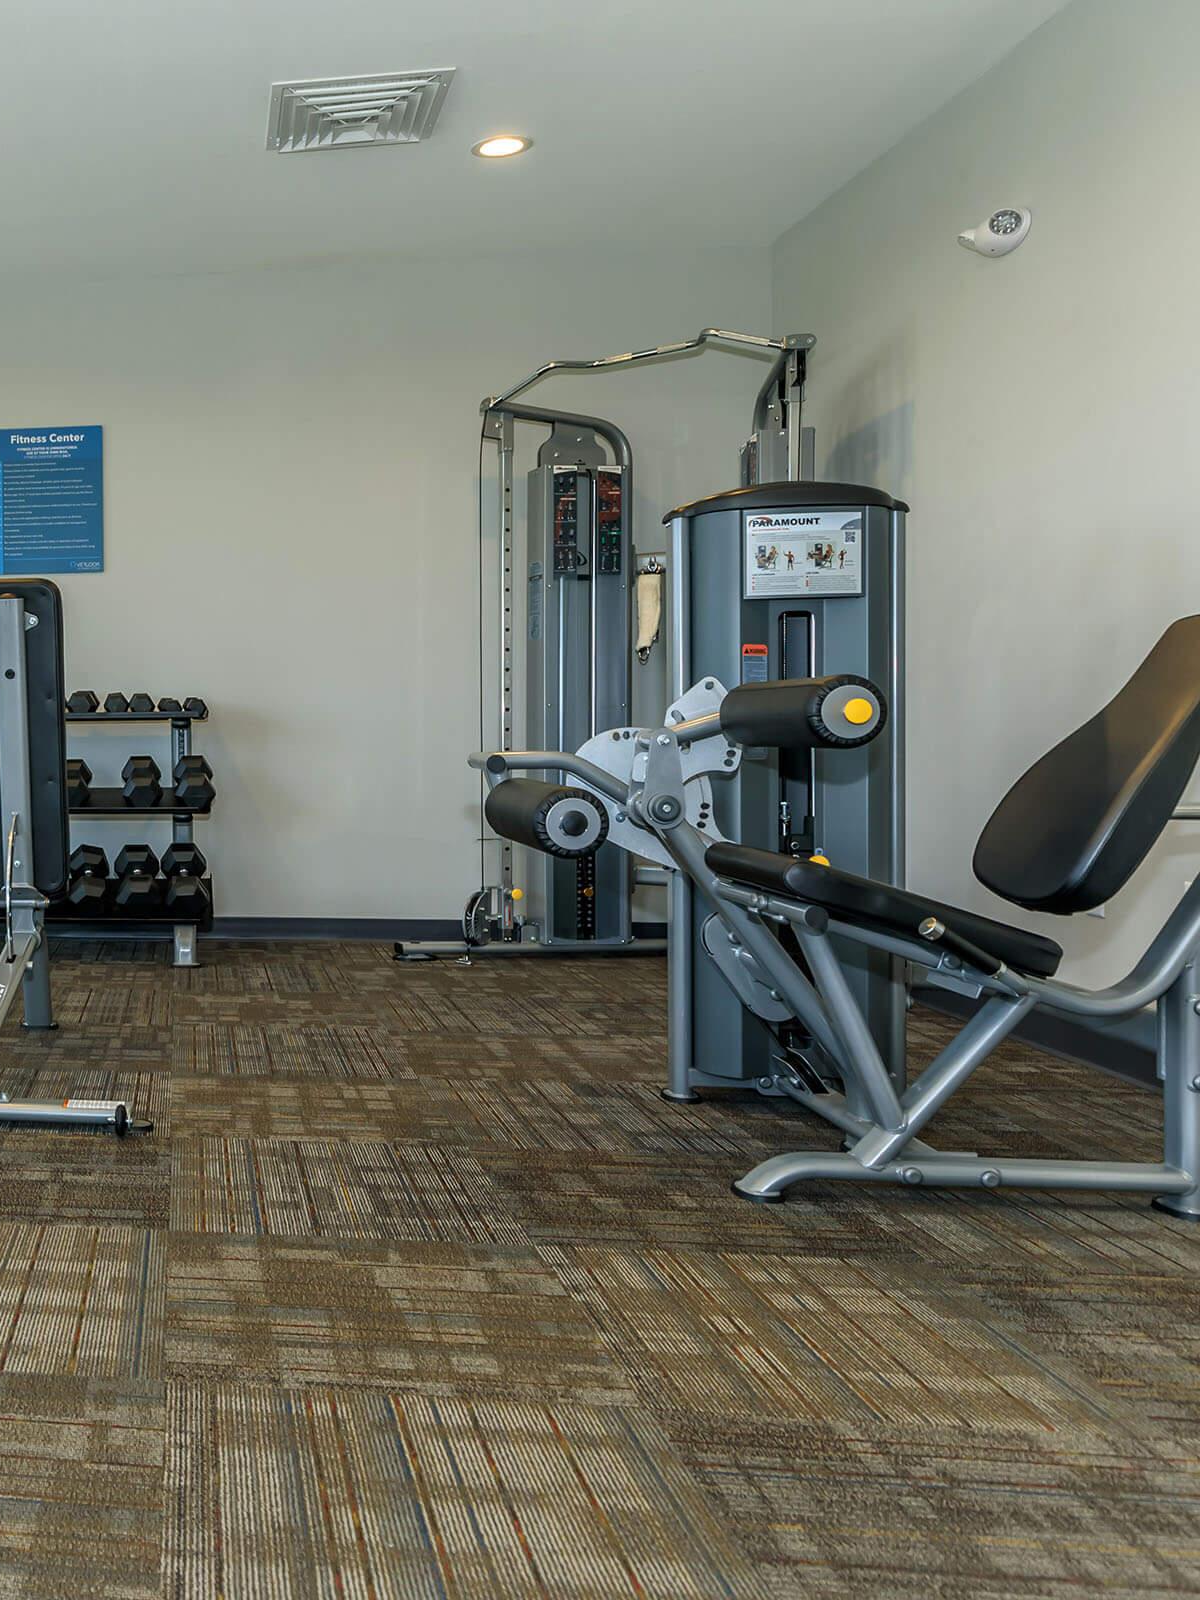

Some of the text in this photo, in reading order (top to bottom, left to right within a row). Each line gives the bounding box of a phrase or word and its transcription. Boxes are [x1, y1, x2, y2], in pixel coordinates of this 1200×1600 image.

[10, 433, 85, 444] Fitness Center
[752, 517, 820, 527] PARAMOUNT
